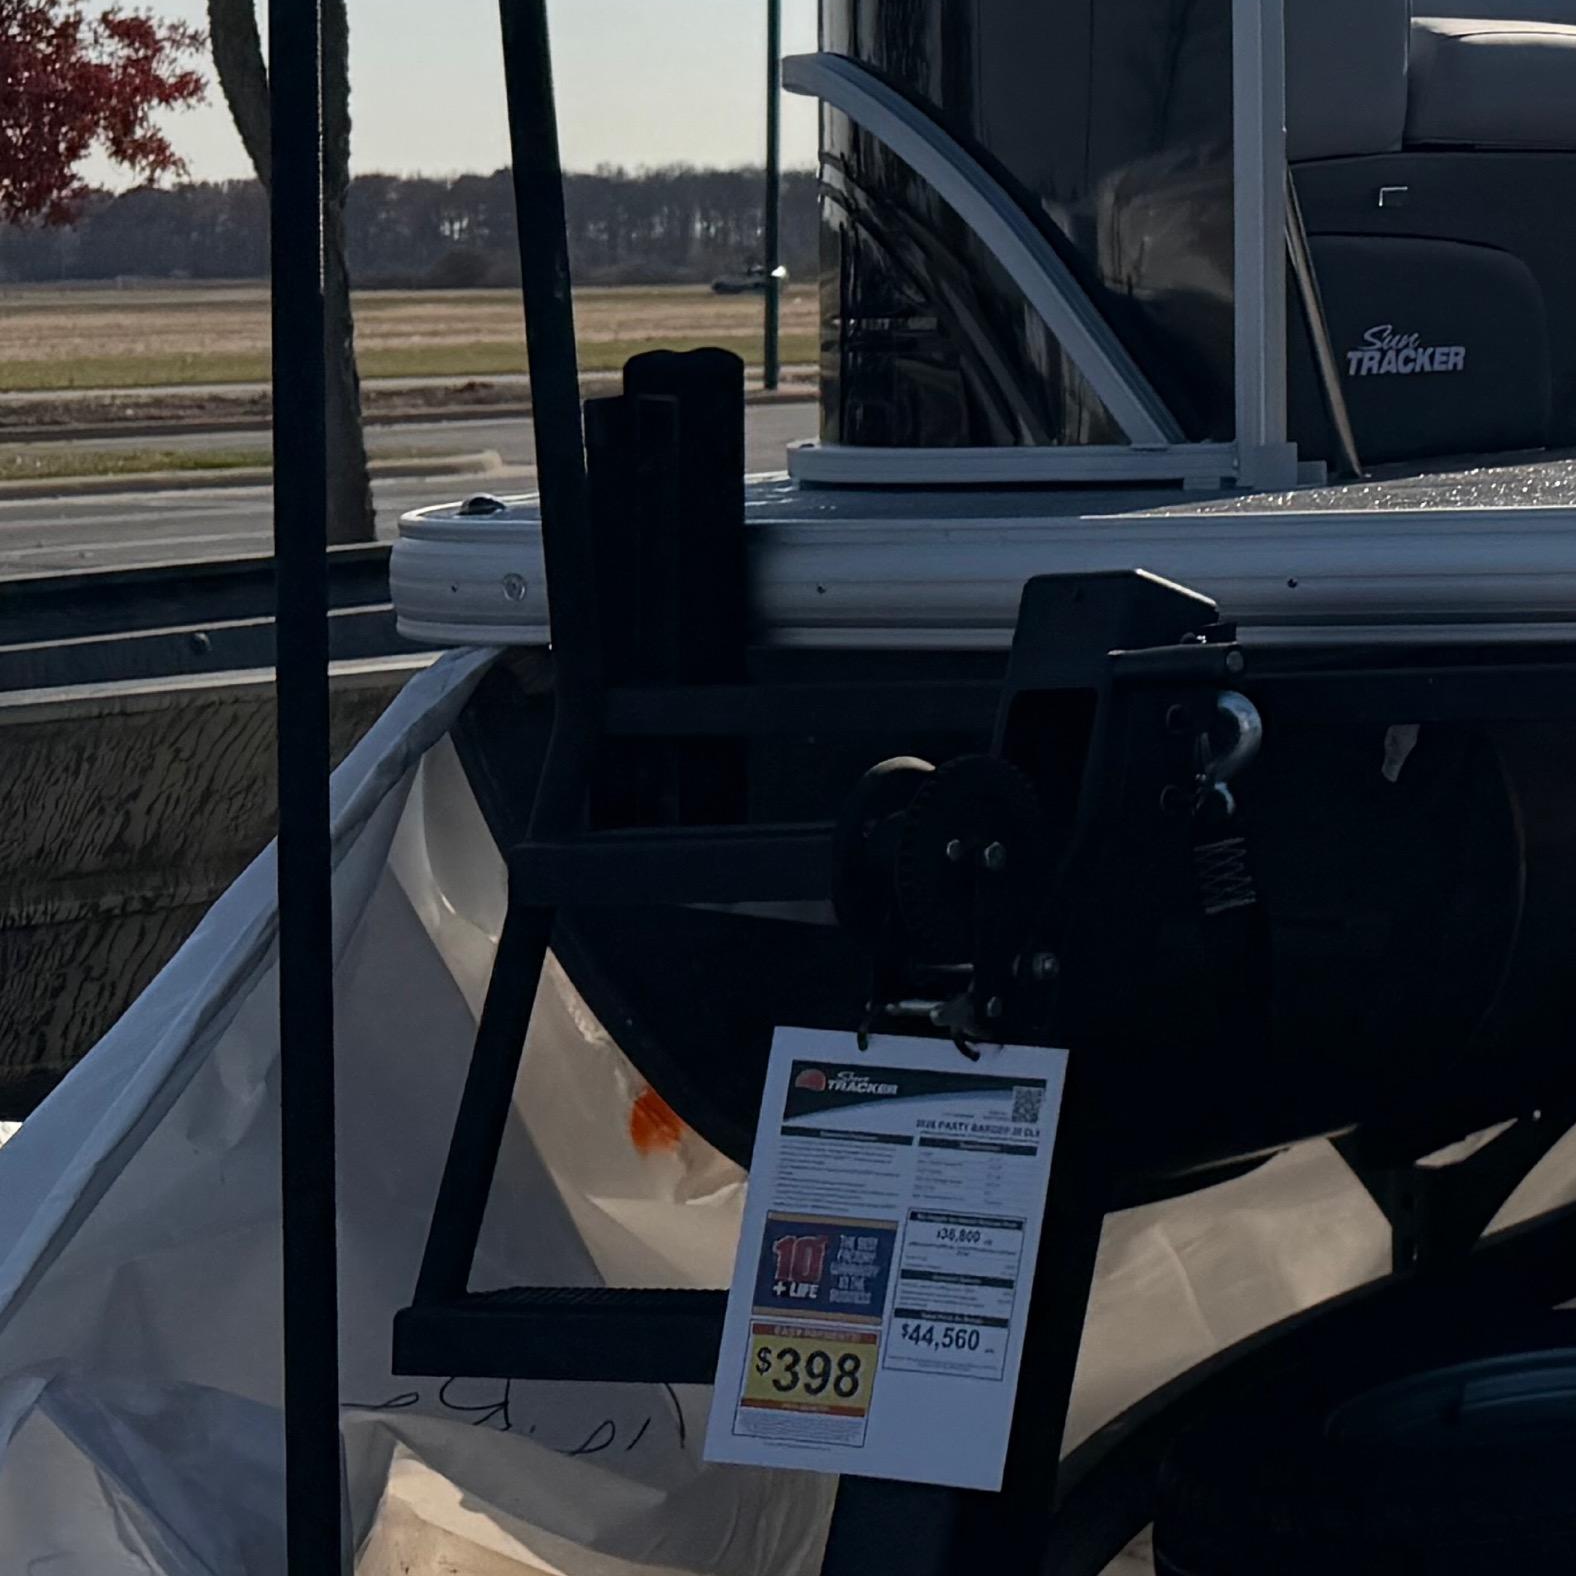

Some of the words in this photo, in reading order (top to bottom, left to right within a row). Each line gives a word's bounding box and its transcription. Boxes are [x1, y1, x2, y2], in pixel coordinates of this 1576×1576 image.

[1359, 324, 1421, 350] Sun
[1347, 346, 1466, 375] TRACKER
[827, 1080, 899, 1095] TRACKER
[772, 1235, 827, 1282] 10
[789, 1281, 819, 1300] LIFE
[902, 1323, 980, 1353] $44,560
[756, 1346, 862, 1398] $398
